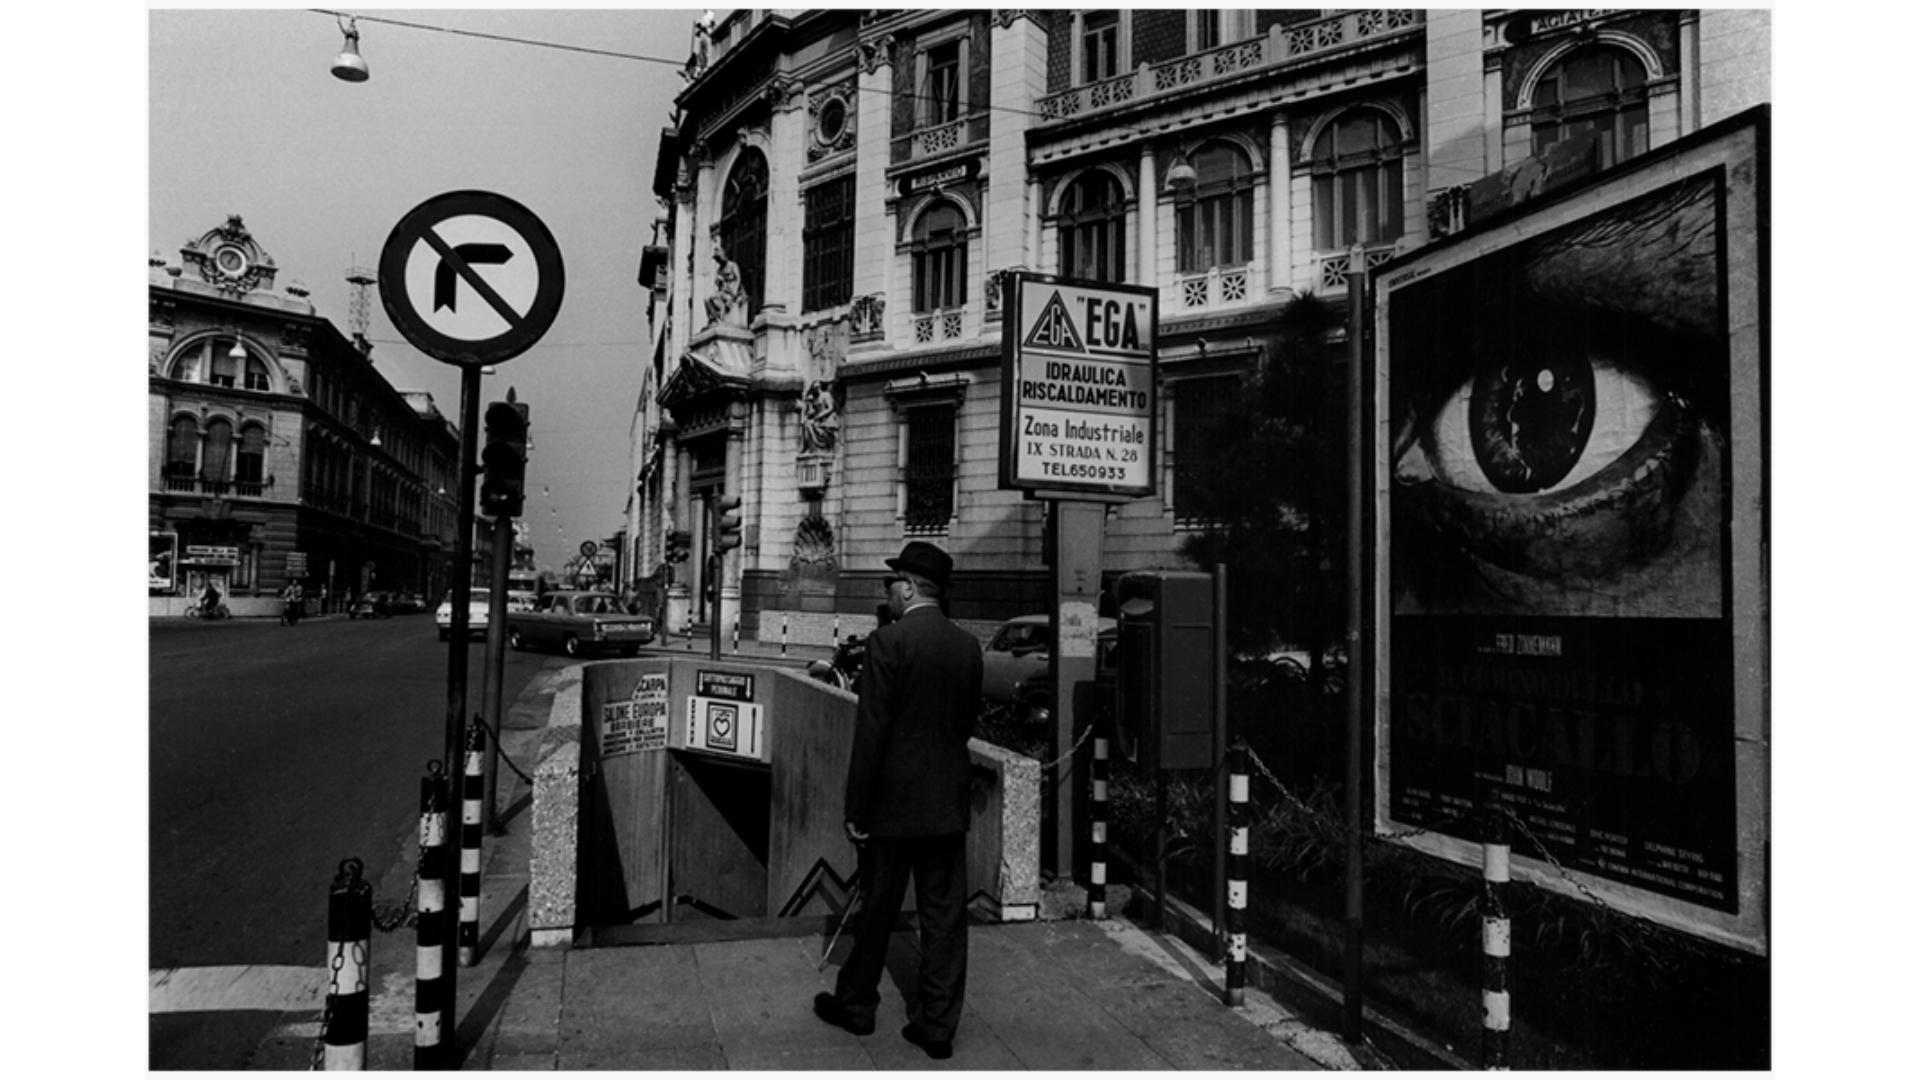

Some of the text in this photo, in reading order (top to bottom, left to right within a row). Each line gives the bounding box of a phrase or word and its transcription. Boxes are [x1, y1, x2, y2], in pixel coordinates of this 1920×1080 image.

[1046, 362, 1127, 387] IDRAULICA
[1022, 381, 1147, 410] RISCALDAMENTO
[1024, 415, 1144, 444] Zona Industriale
[1027, 442, 1043, 456] IX
[1049, 443, 1101, 460] STRADA
[1121, 449, 1138, 463] 28
[1406, 692, 1701, 785] SCIACALLO
